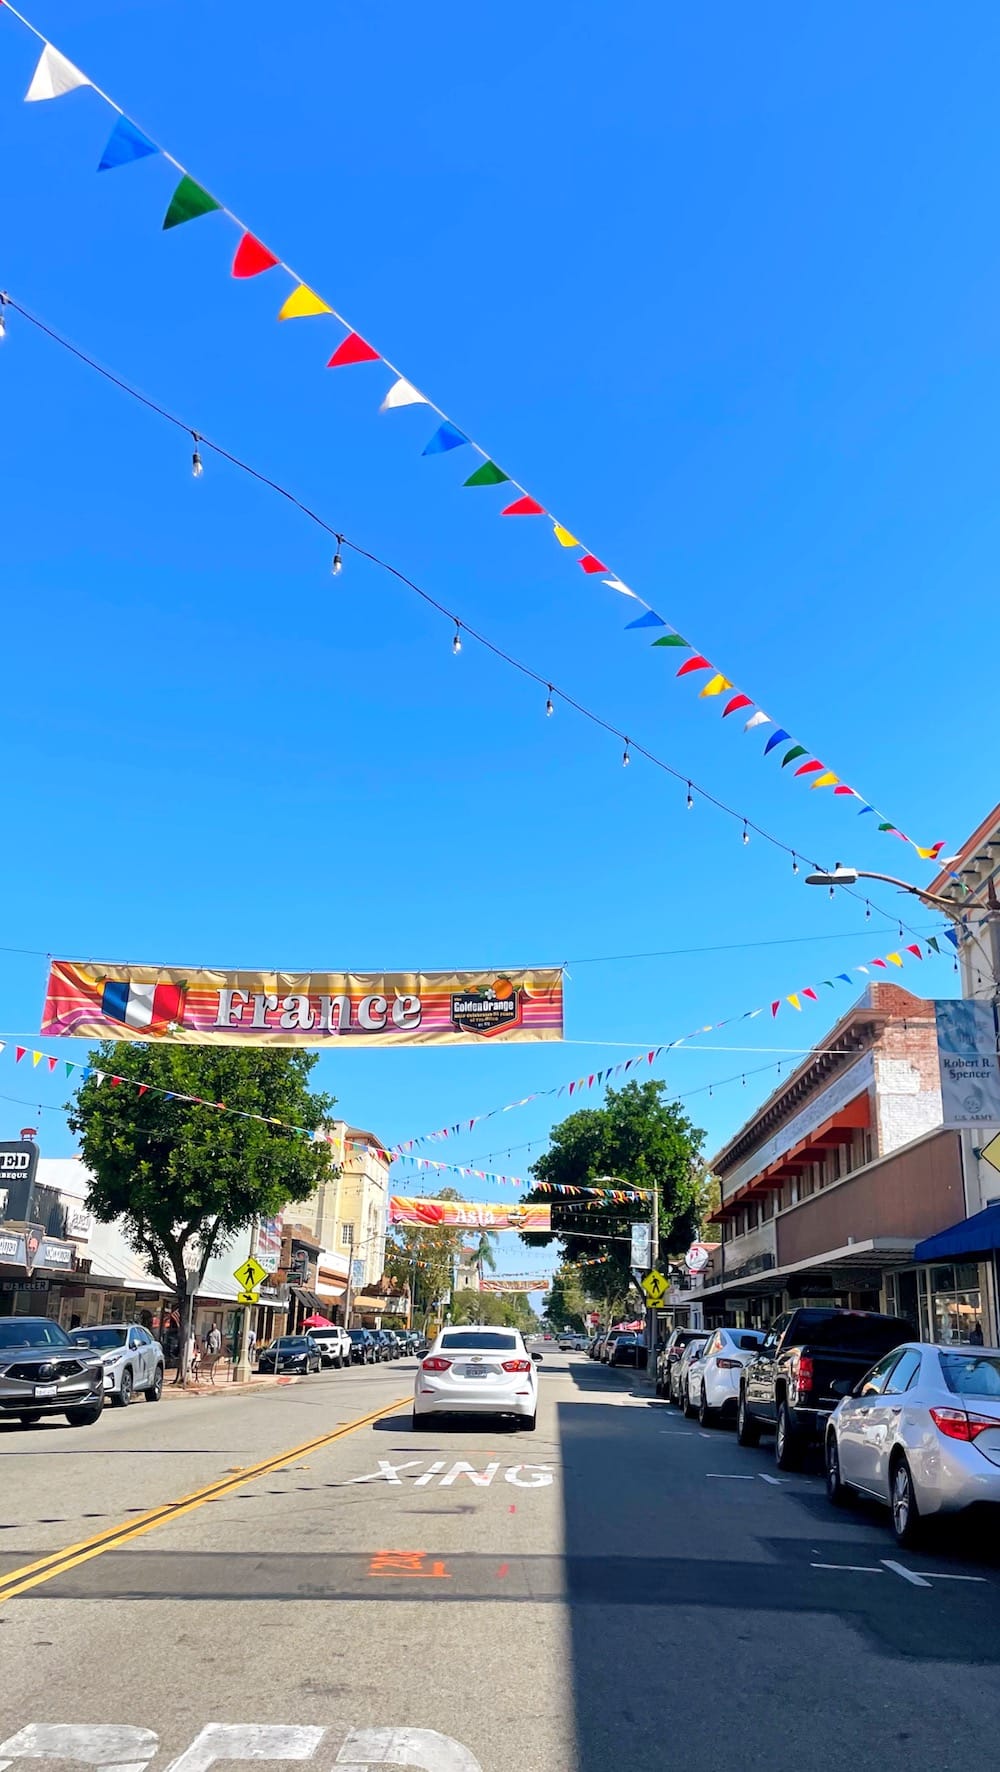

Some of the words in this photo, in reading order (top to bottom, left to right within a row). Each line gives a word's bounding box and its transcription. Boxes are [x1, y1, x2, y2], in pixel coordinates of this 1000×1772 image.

[213, 988, 422, 1030] France
[943, 1058, 979, 1068] Robert
[982, 1058, 995, 1068] R.
[949, 1069, 992, 1080] Spencer
[0, 1152, 30, 1170] ED
[0, 1172, 29, 1180] BEQUE
[346, 1460, 554, 1487] XING
